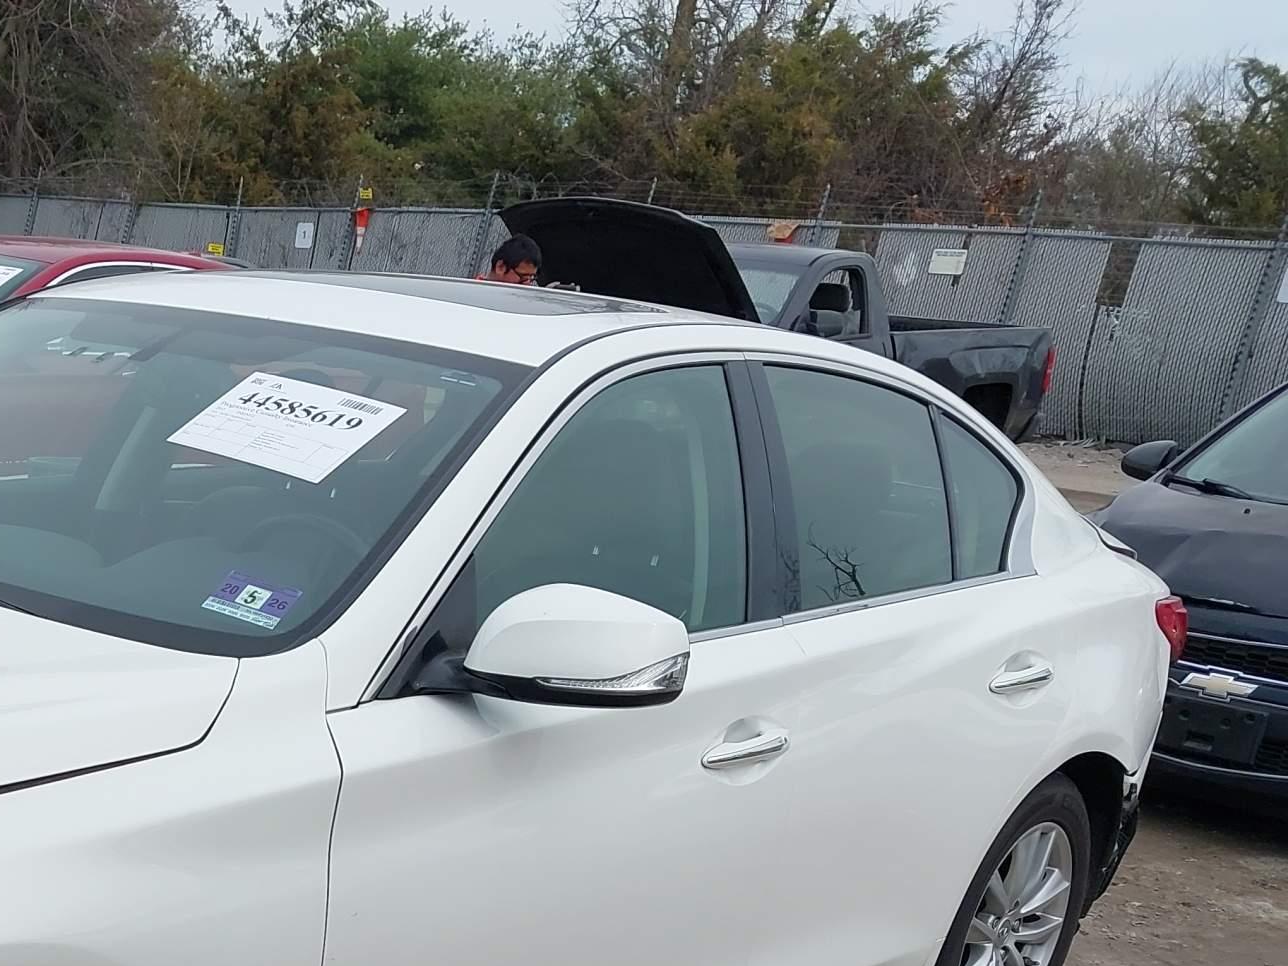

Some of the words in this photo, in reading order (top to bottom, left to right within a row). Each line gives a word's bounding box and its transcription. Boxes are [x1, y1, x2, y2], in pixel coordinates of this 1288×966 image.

[238, 392, 363, 430] 44585619
[221, 583, 240, 595] 20
[244, 590, 261, 604] 5
[267, 598, 288, 610] 26
